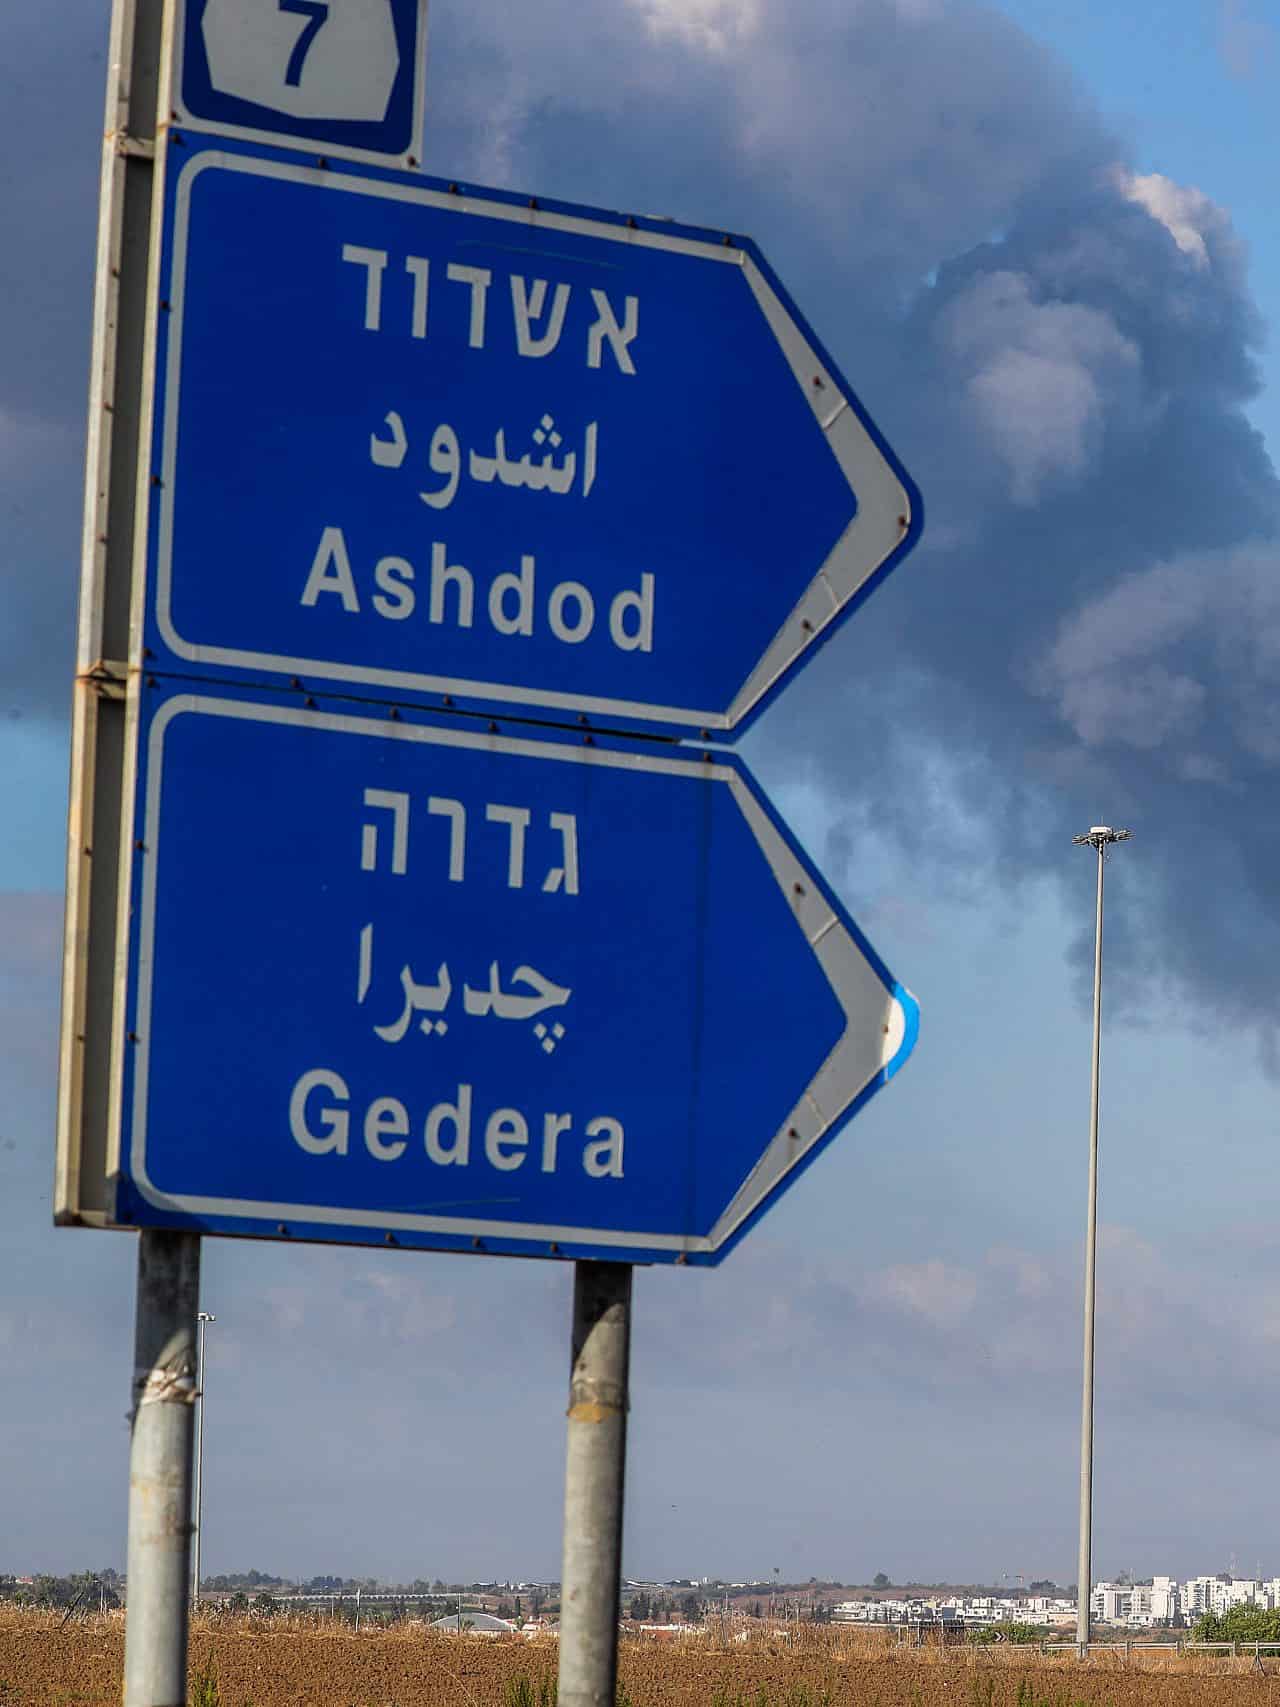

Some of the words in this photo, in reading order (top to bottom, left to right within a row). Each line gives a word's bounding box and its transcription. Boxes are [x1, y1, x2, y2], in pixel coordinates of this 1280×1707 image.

[278, 0, 329, 87] 7
[341, 245, 638, 375] אשדוד
[370, 411, 597, 508] اشدود
[301, 527, 655, 653] Ashdod
[360, 788, 579, 895] גדרה
[288, 1069, 625, 1178] Gedera
